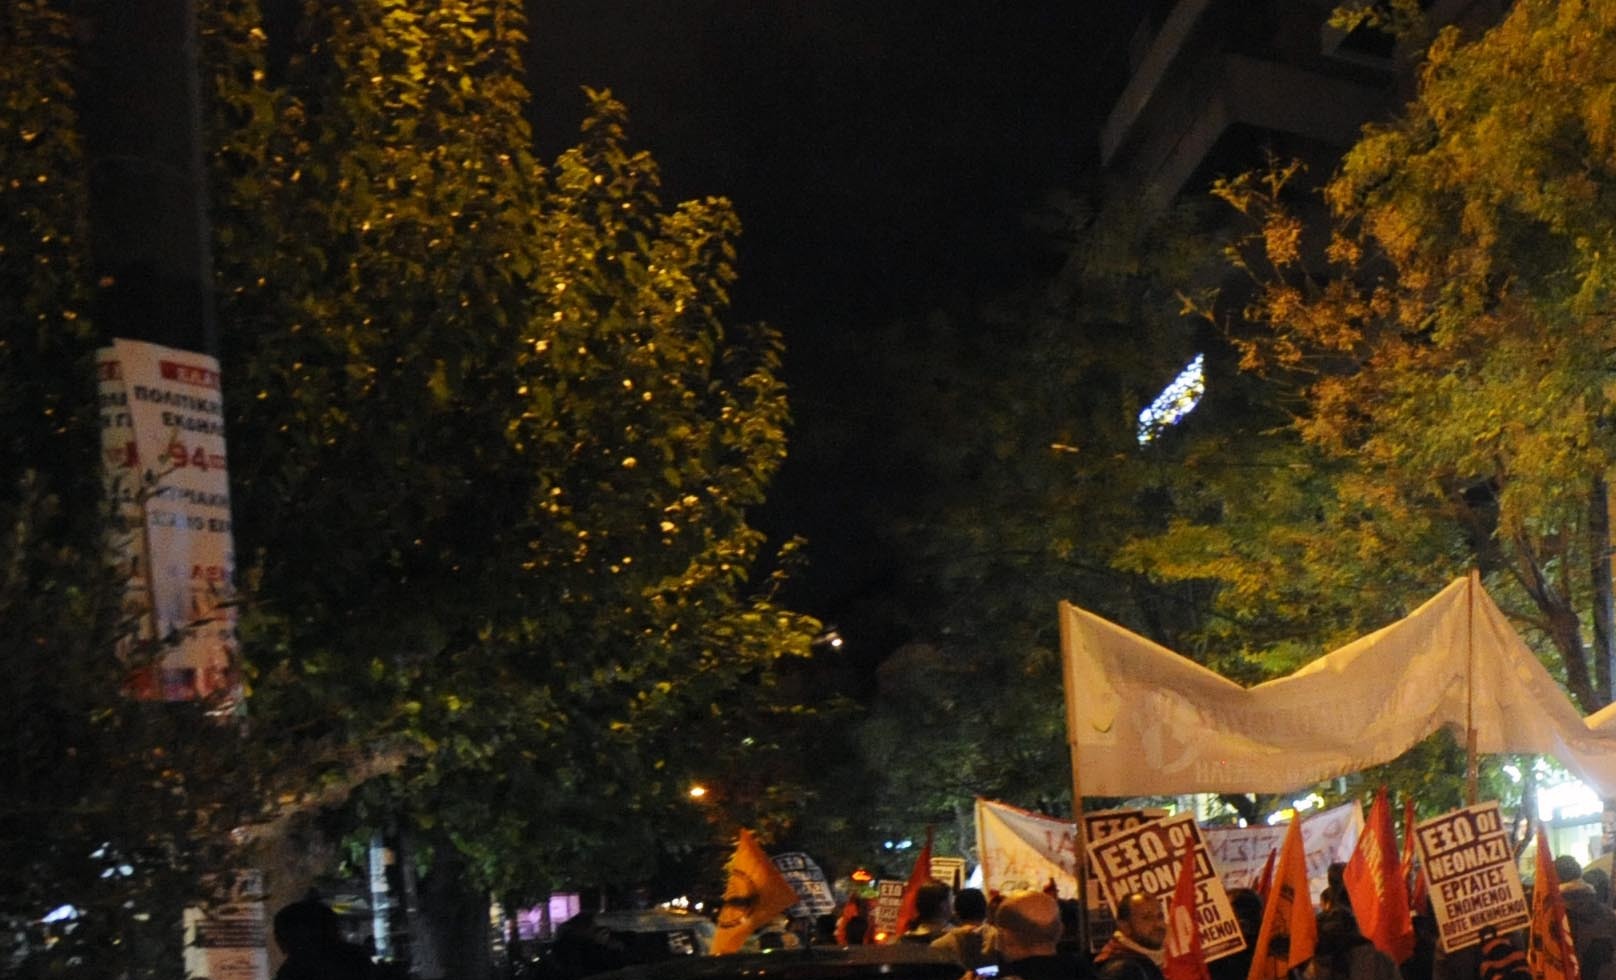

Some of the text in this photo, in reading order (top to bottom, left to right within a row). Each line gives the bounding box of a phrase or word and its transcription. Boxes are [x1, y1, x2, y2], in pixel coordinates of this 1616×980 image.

[1101, 831, 1168, 878] ΕΞΩ
[1422, 811, 1497, 857] ΕΞΩ ΟΙ
[1428, 837, 1508, 881] ΝΕΟΝΑΖΙ
[1441, 865, 1509, 901] ΕΡΓΑΤΕΣ
[1446, 885, 1513, 918] ΕΝΩΜΕΝΟΙ
